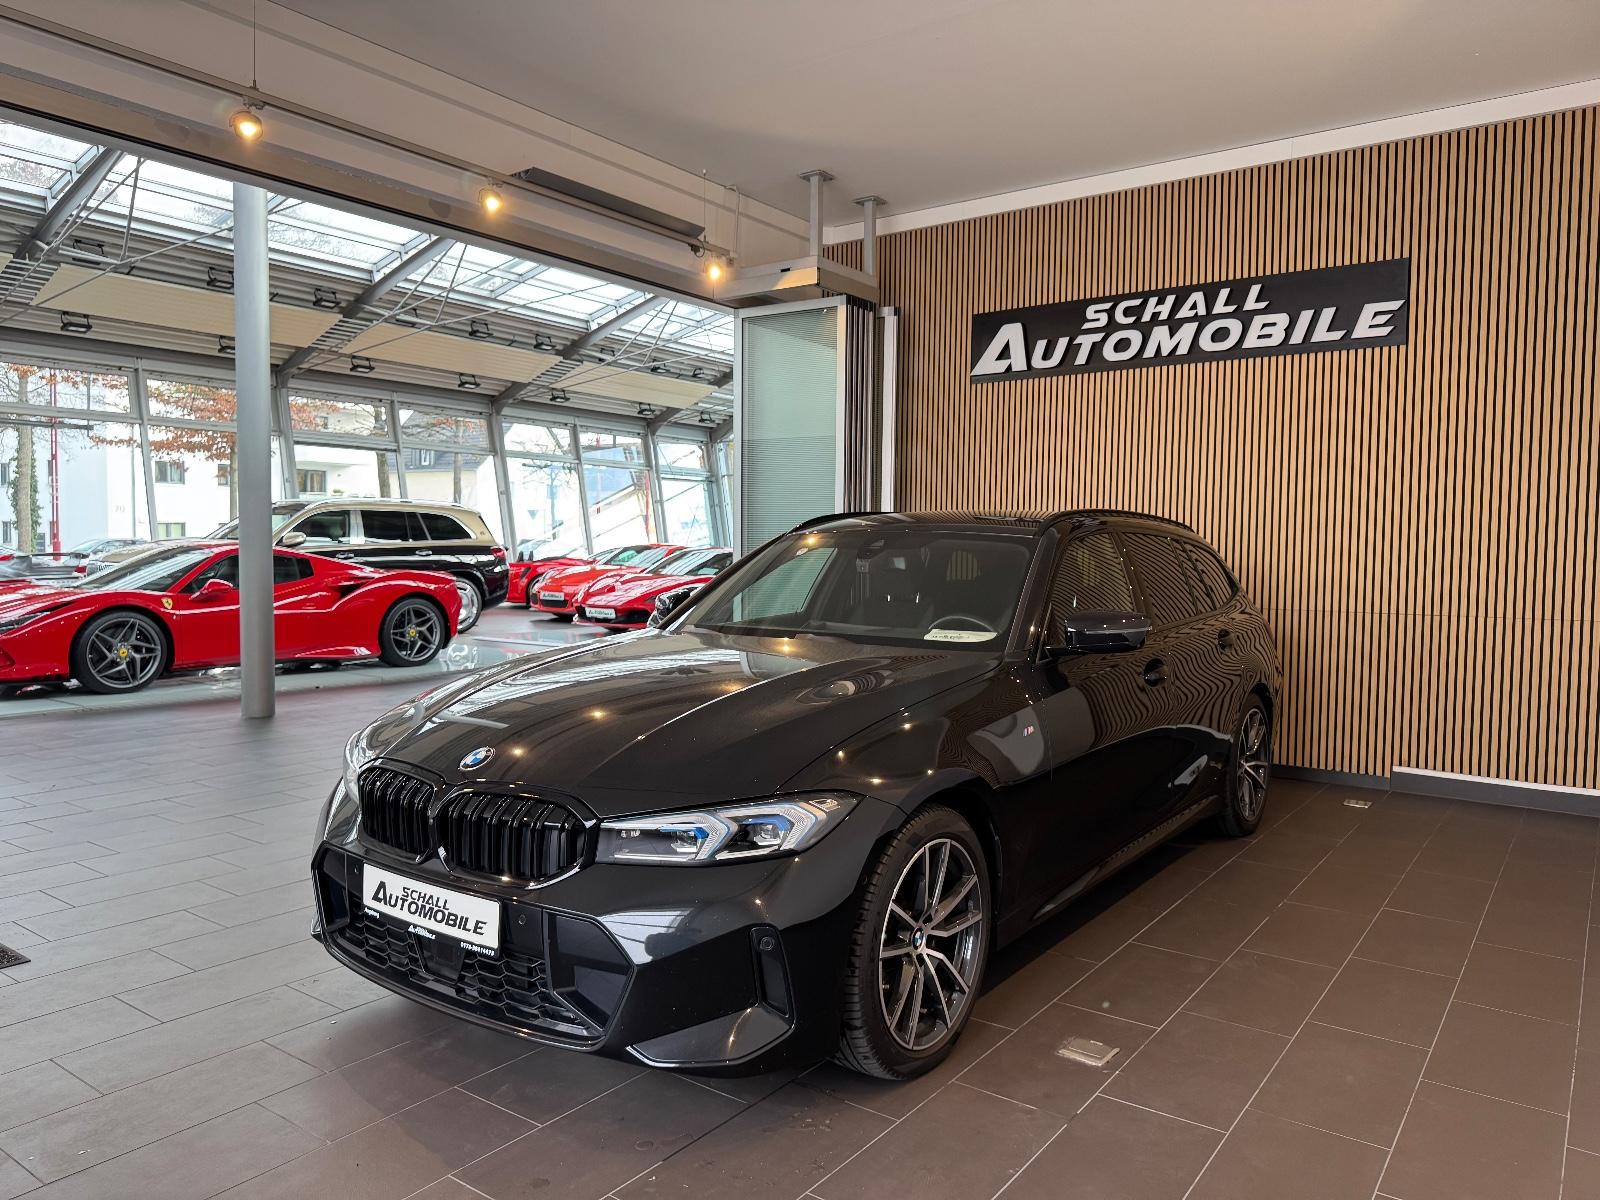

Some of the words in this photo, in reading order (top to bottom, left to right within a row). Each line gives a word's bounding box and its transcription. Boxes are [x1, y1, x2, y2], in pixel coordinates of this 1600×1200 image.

[1081, 284, 1272, 329] SCHALL
[970, 299, 1406, 376] AUTOMOBILE
[371, 880, 487, 936] AUTOMOBILE
[402, 886, 450, 911] SCHALL
